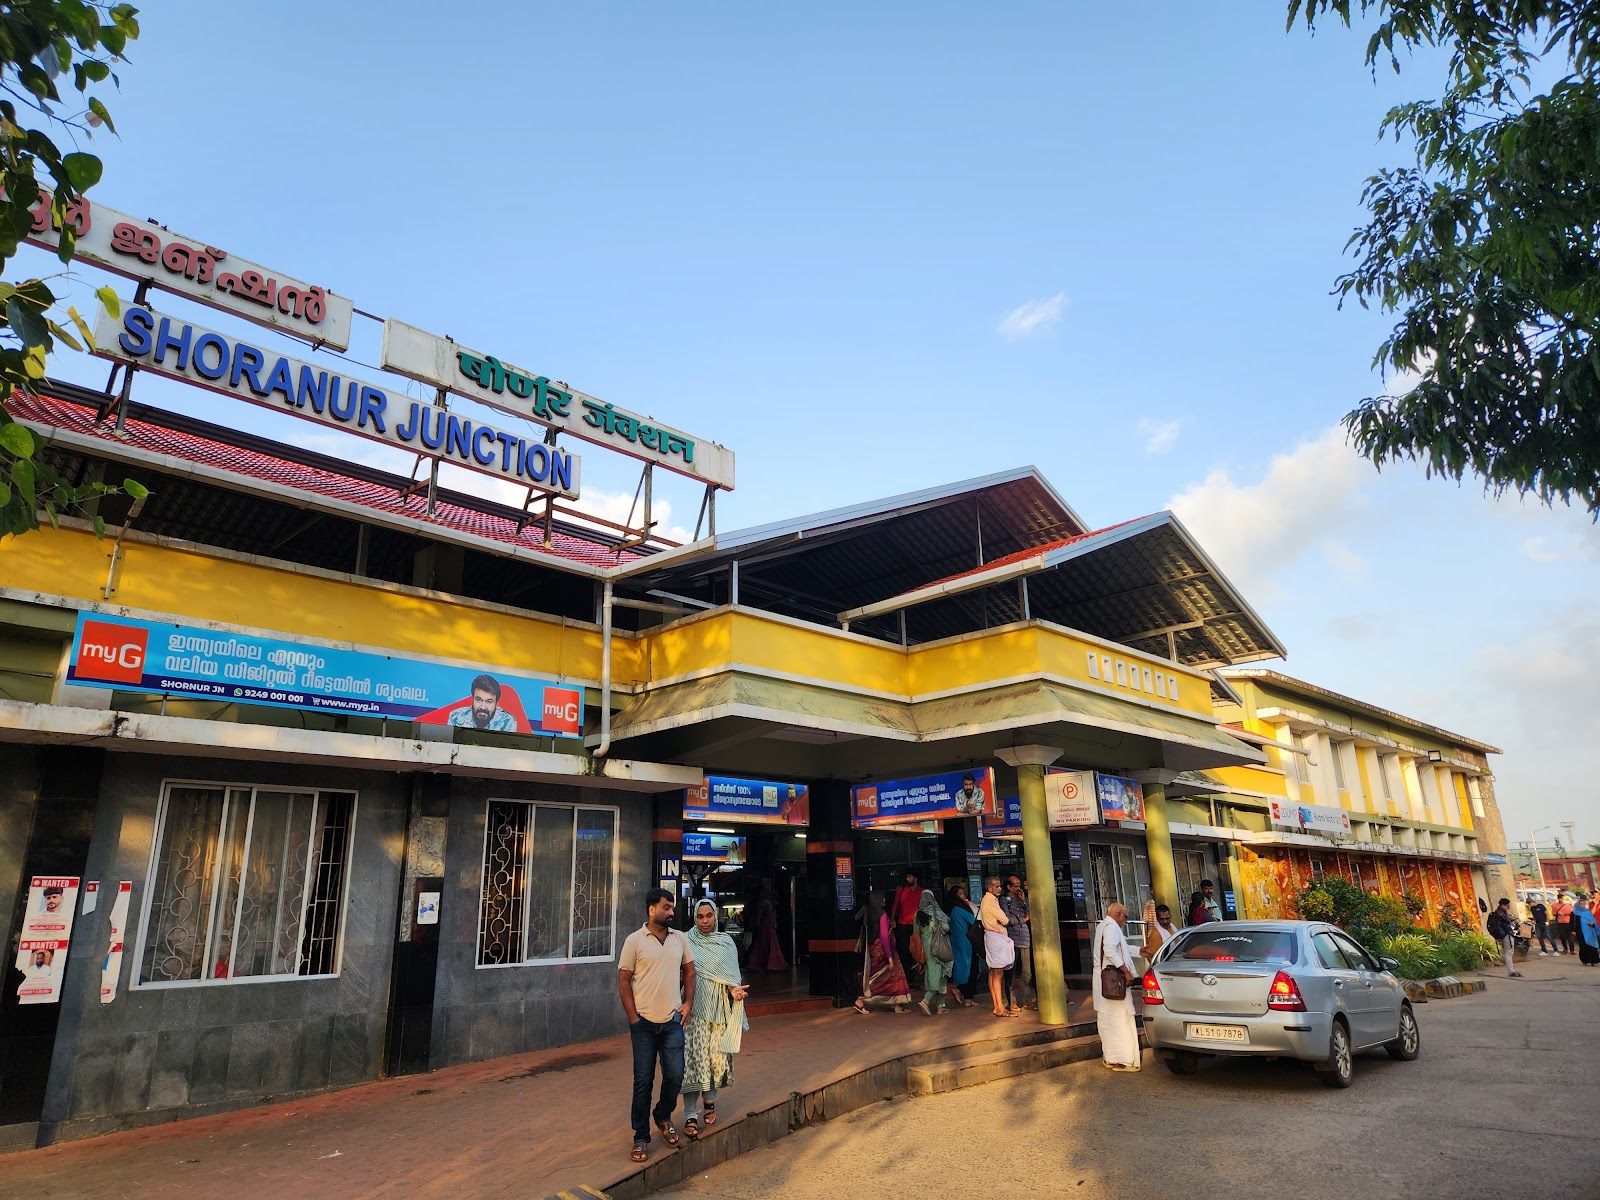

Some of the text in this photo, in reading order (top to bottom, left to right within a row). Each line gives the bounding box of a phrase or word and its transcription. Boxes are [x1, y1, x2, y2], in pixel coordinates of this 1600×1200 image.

[118, 306, 573, 491] SHORANUR JUNCTION
[582, 399, 695, 464] जंक्शन
[82, 642, 142, 668] myG
[164, 655, 219, 676] വലിയ
[160, 679, 225, 694] SHORNUR JN
[244, 688, 304, 704] 9249 001 001
[320, 697, 380, 712] www.myg.in
[544, 702, 578, 722] myG
[687, 786, 708, 800] myG
[857, 795, 878, 809] myG
[661, 859, 680, 877] IN
[41, 879, 70, 888] WANTED
[29, 941, 59, 950] WANTED
